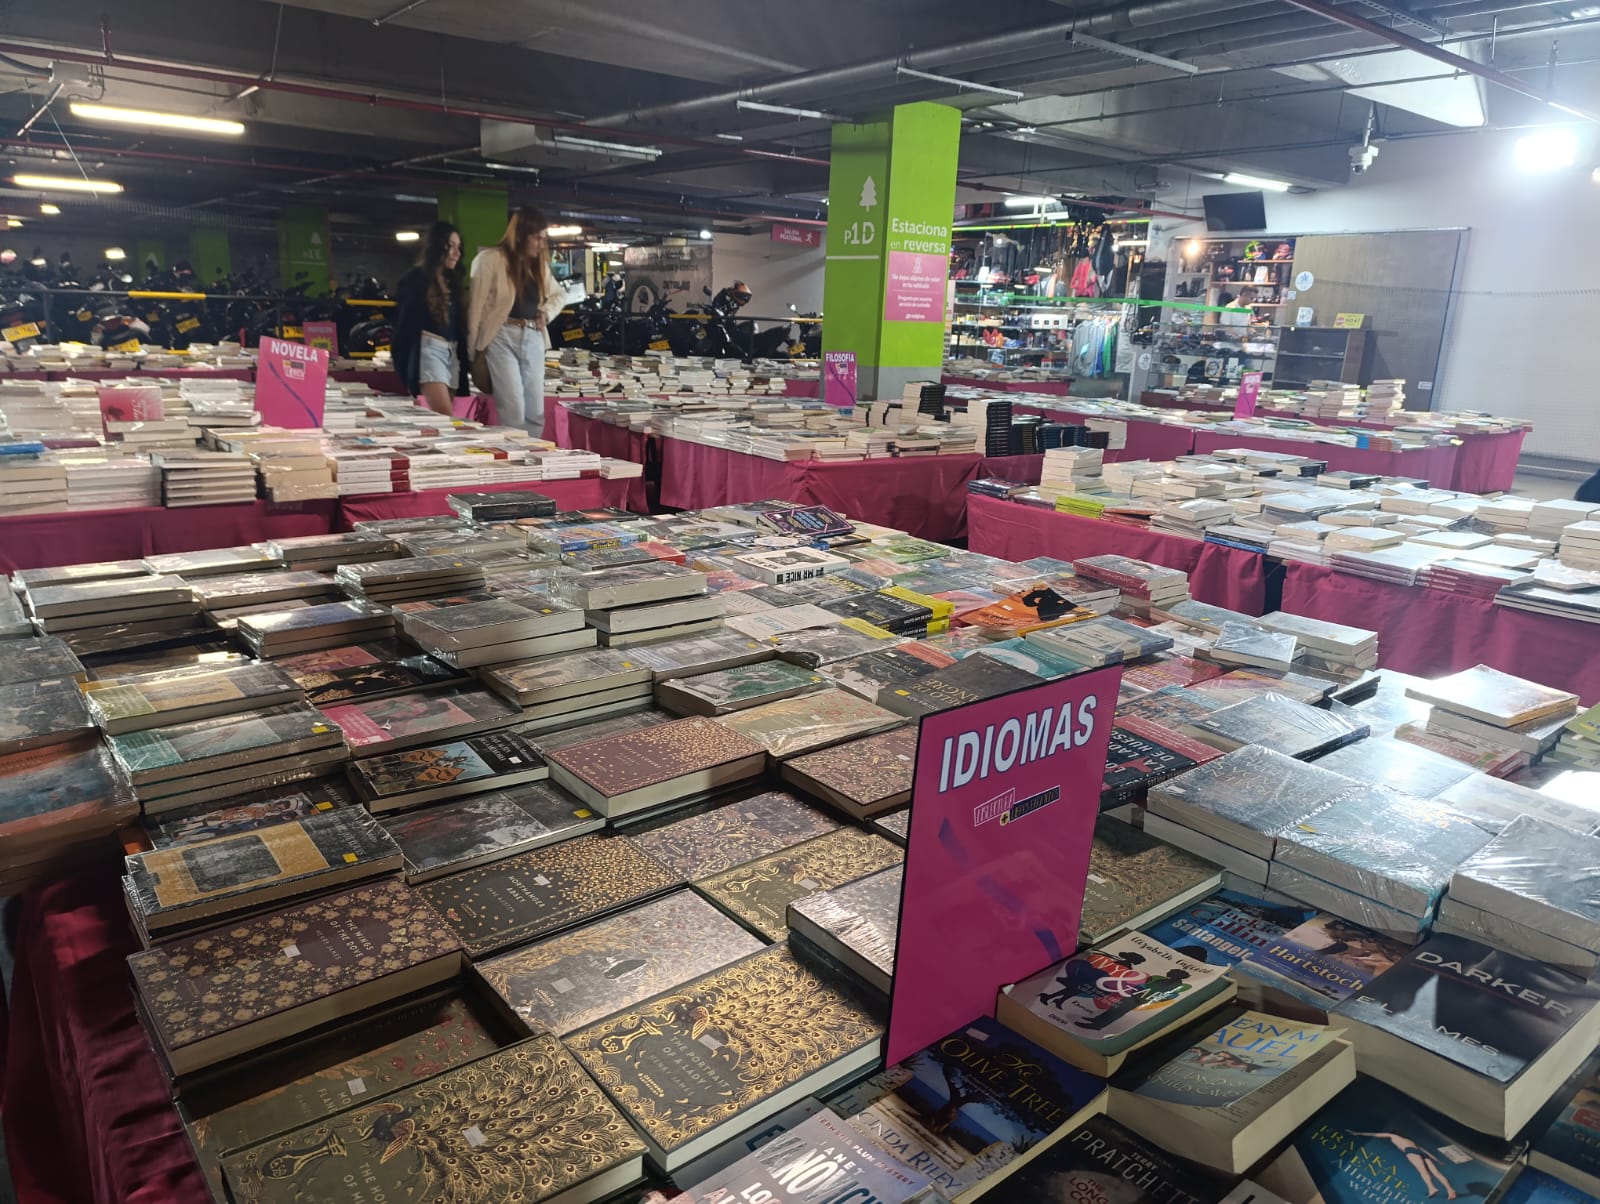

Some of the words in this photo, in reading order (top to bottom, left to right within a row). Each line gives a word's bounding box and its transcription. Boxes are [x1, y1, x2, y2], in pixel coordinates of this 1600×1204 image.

[892, 218, 947, 237] Estaciona
[890, 240, 900, 249] en
[903, 239, 946, 254] reversa
[271, 341, 318, 362] NOVELA
[786, 570, 803, 583] NICE
[938, 695, 1098, 793] IDIOMAS
[1108, 741, 1140, 758] LAD
[1111, 730, 1153, 752] HUESO
[1143, 759, 1166, 771] LA
[1151, 751, 1175, 762] DE
[329, 920, 340, 929] OF
[337, 928, 351, 941] THE
[346, 940, 364, 958] DOVE
[354, 930, 375, 951] WINGS
[1189, 908, 1271, 949] Collin
[1093, 955, 1122, 977] IVY
[1269, 945, 1364, 991] Hartstoch
[1415, 951, 1575, 1017] DARKER
[1213, 1028, 1301, 1059] AUEL
[1231, 1017, 1289, 1038] EAN
[1288, 1031, 1321, 1043] M
[649, 1053, 672, 1076] HENRY
[671, 1076, 694, 1097] JAMES
[662, 1046, 675, 1057] OF
[682, 1064, 707, 1085] LADY
[670, 1036, 689, 1054] THE
[686, 1051, 731, 1089] PORTRAIT
[993, 1053, 1042, 1080] The
[941, 1038, 1004, 1082] OLIVE
[1008, 1079, 1061, 1122] TREE
[837, 1094, 909, 1156] LUCINDA
[818, 1141, 865, 1176] JANET
[852, 1144, 876, 1162] PLUM
[1130, 1151, 1158, 1171] TERRY
[1319, 1125, 1397, 1176] FRANKA
[343, 1174, 358, 1188] OF
[906, 1148, 962, 1190] RILEY
[360, 1162, 377, 1184] THE
[370, 1185, 389, 1204] HO
[1069, 1176, 1109, 1204] LONG
[1070, 1190, 1092, 1204] CO
